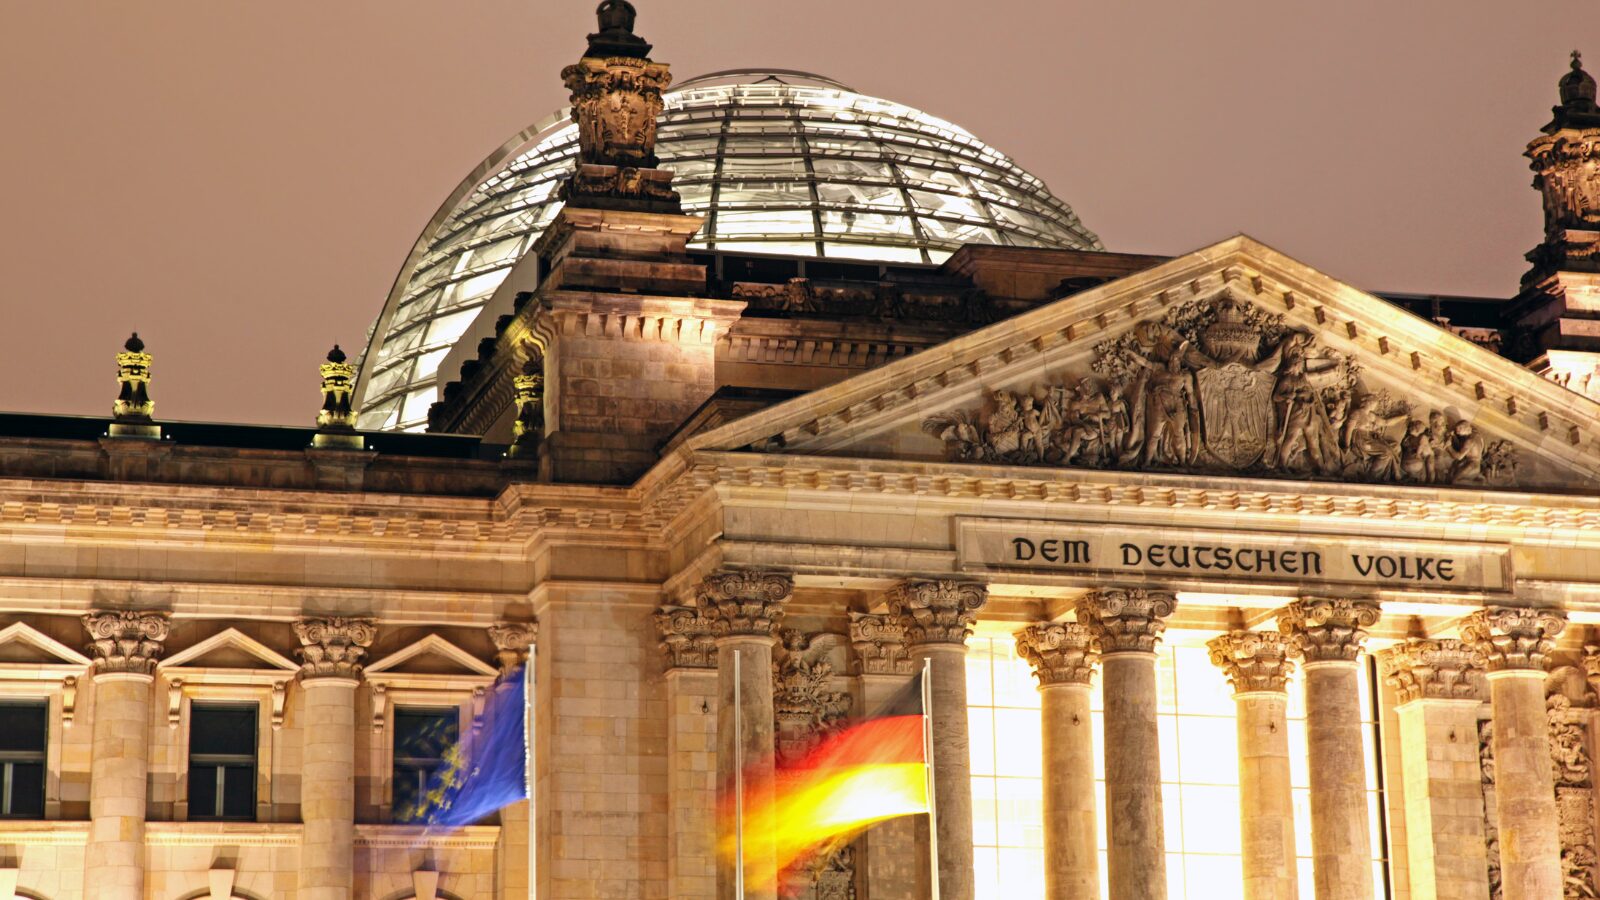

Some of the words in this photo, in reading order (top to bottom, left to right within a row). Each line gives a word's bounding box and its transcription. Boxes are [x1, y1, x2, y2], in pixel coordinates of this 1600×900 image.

[1012, 537, 1091, 564] DEM
[1120, 543, 1322, 575] DEUTSCHEN
[1351, 554, 1455, 581] VOLKE
